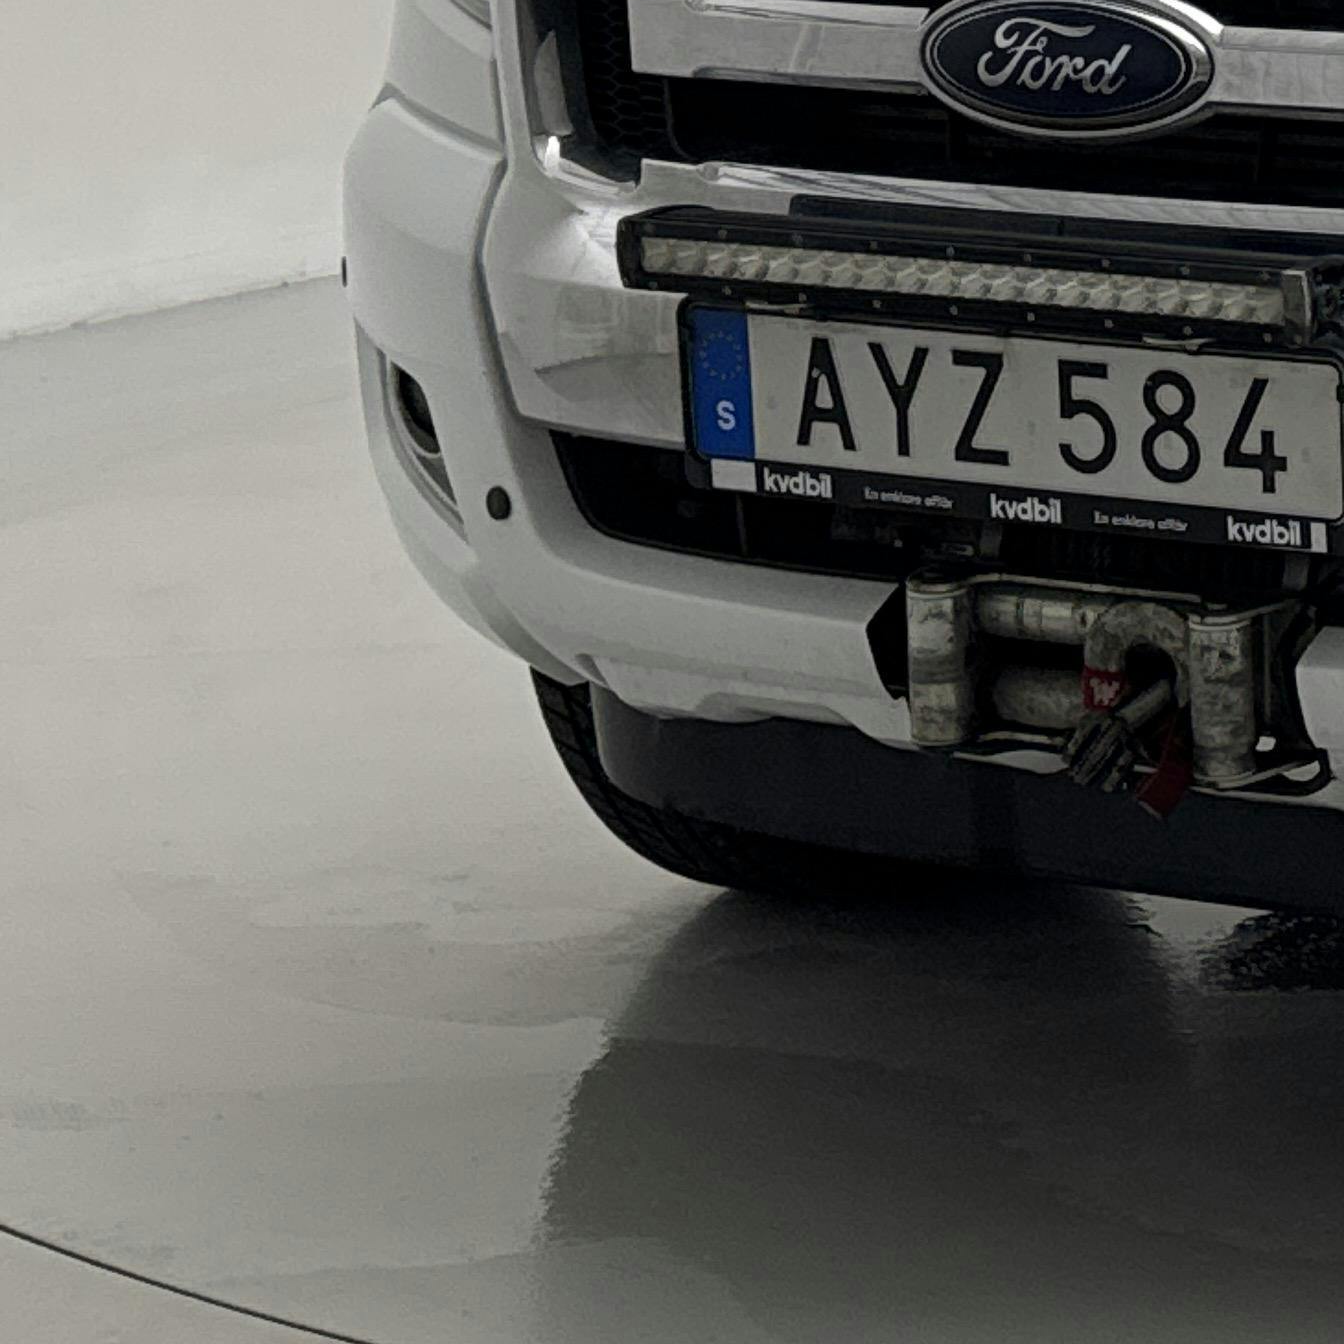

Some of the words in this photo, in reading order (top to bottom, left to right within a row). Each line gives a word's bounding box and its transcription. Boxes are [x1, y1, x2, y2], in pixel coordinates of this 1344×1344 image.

[976, 17, 1132, 94] Ford
[717, 400, 736, 431] S
[796, 336, 1010, 466] AYZ
[1057, 359, 1288, 494] 584
[763, 467, 832, 498] kvdbil
[990, 493, 1062, 524] kvdbil
[1227, 515, 1301, 546] kvdbil
